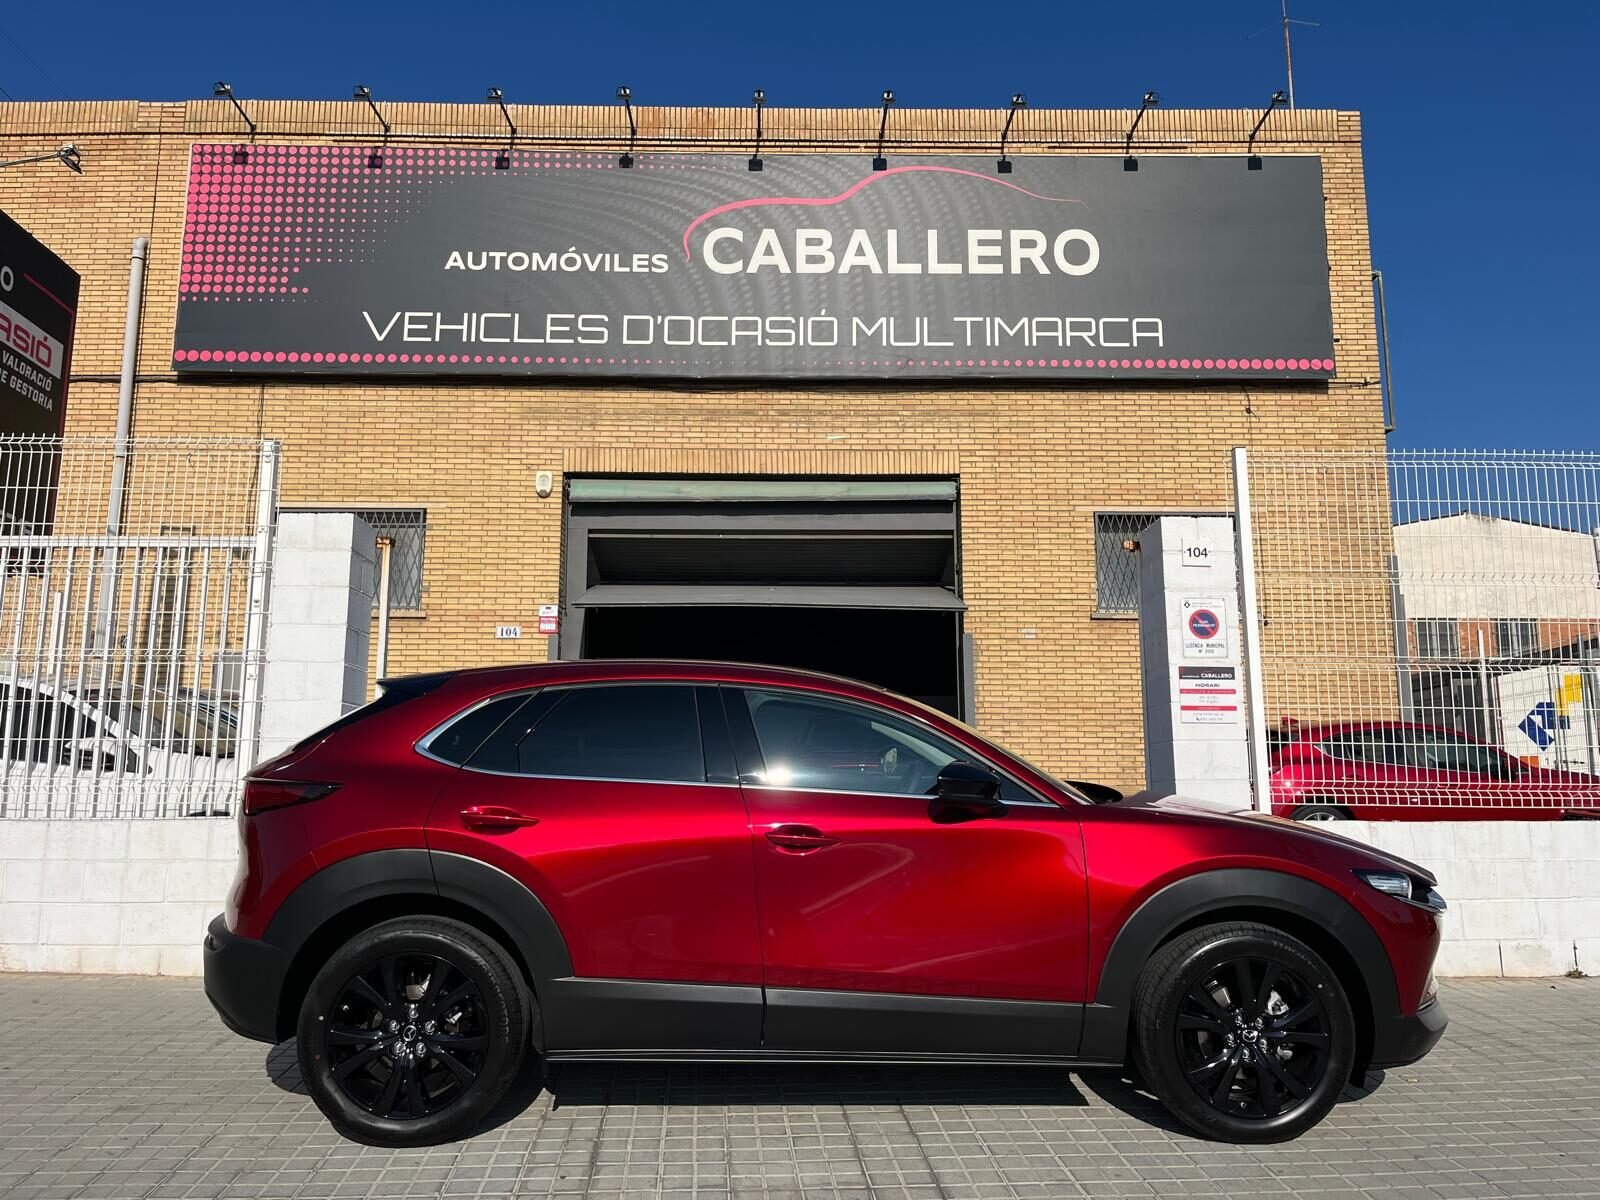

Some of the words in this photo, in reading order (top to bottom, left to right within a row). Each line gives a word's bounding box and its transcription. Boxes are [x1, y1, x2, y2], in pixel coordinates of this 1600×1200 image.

[444, 246, 670, 274] AUTOMÓVILES
[702, 226, 1101, 276] CABALLERO
[363, 311, 610, 346] VEHICLES
[622, 308, 839, 348] D'OCASIÓ
[851, 315, 1165, 348] MULTIMARCA
[2, 350, 52, 392] VALORACIÓ
[10, 375, 53, 412] GESTORIA
[1186, 547, 1209, 558] 104
[501, 627, 518, 637] 104
